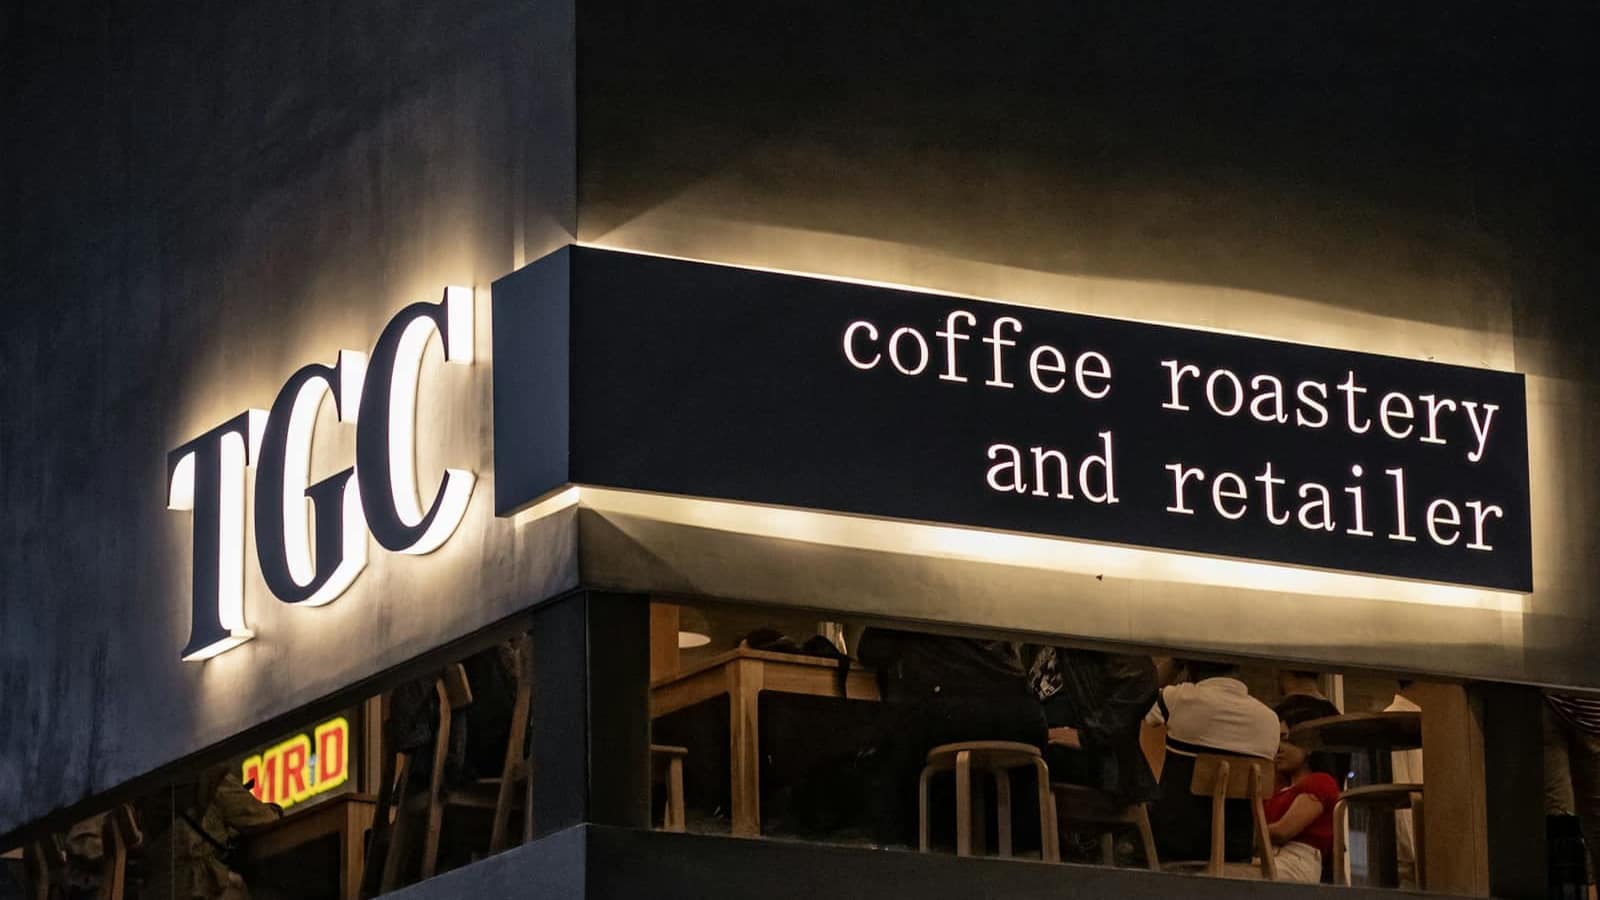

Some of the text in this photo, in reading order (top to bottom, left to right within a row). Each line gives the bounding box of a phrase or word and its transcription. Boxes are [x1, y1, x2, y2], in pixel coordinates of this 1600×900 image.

[843, 310, 1500, 463] coffee roastery
[168, 286, 472, 661] TGC
[986, 430, 1504, 551] and retailer
